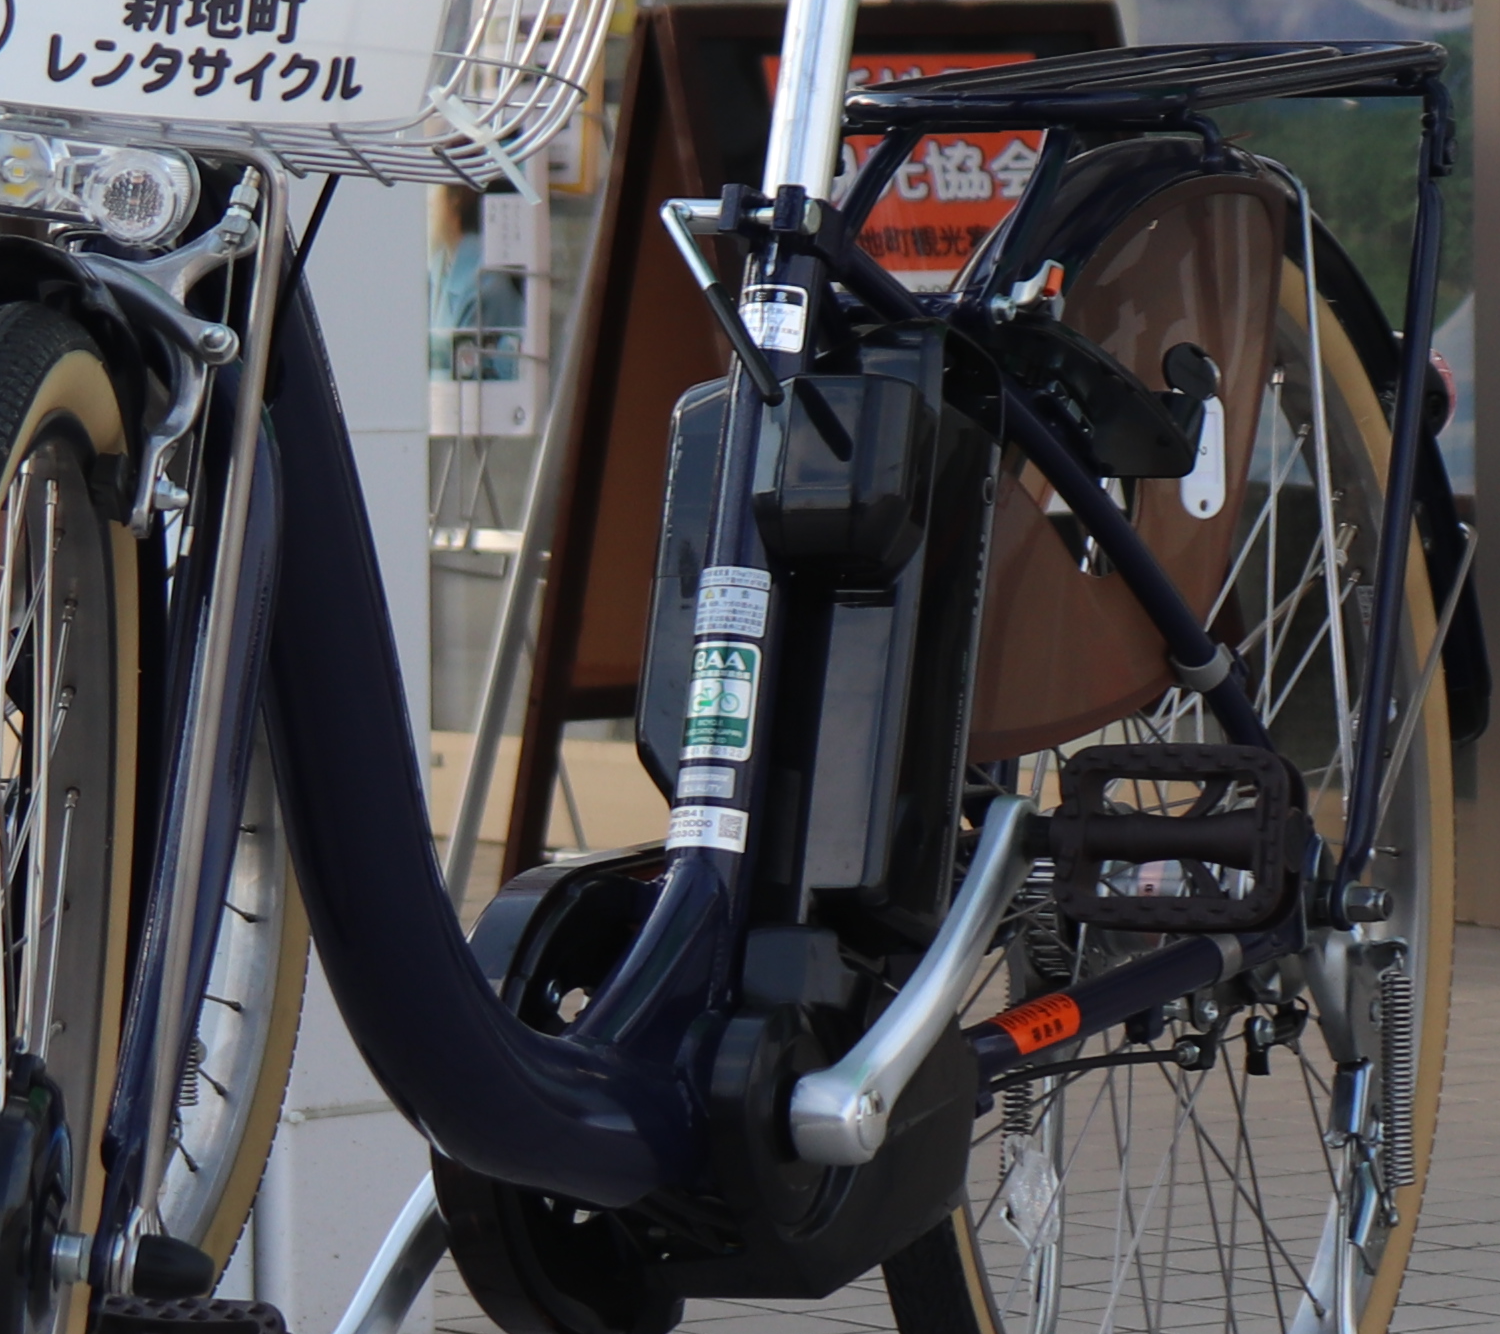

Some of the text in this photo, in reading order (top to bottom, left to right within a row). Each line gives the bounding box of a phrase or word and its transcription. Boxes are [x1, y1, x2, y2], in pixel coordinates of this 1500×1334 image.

[47, 34, 361, 102] レンタサイクル
[693, 650, 747, 671] BAA
